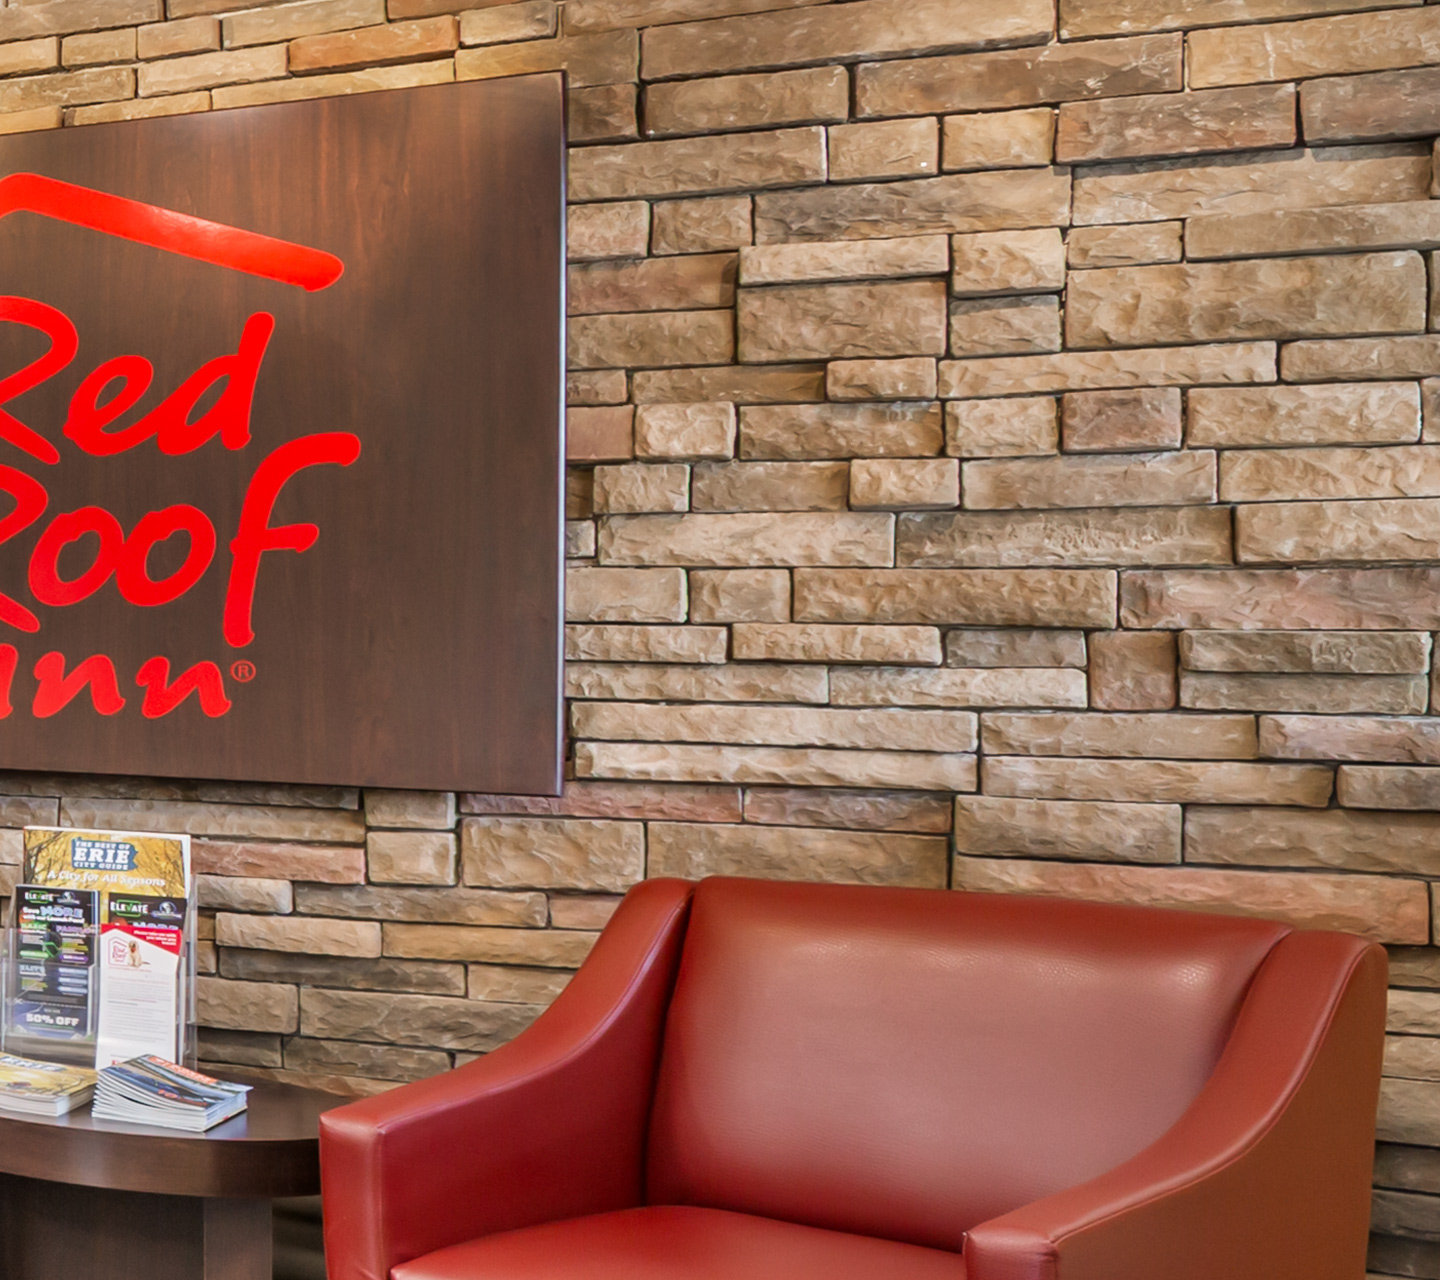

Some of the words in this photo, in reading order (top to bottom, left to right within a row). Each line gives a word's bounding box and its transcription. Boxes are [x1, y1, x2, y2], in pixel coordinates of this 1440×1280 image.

[73, 847, 130, 864] ERIE
[47, 871, 57, 879] A
[102, 873, 118, 883] All
[110, 901, 149, 914] ELEVATE
[55, 1016, 80, 1026] OFF
